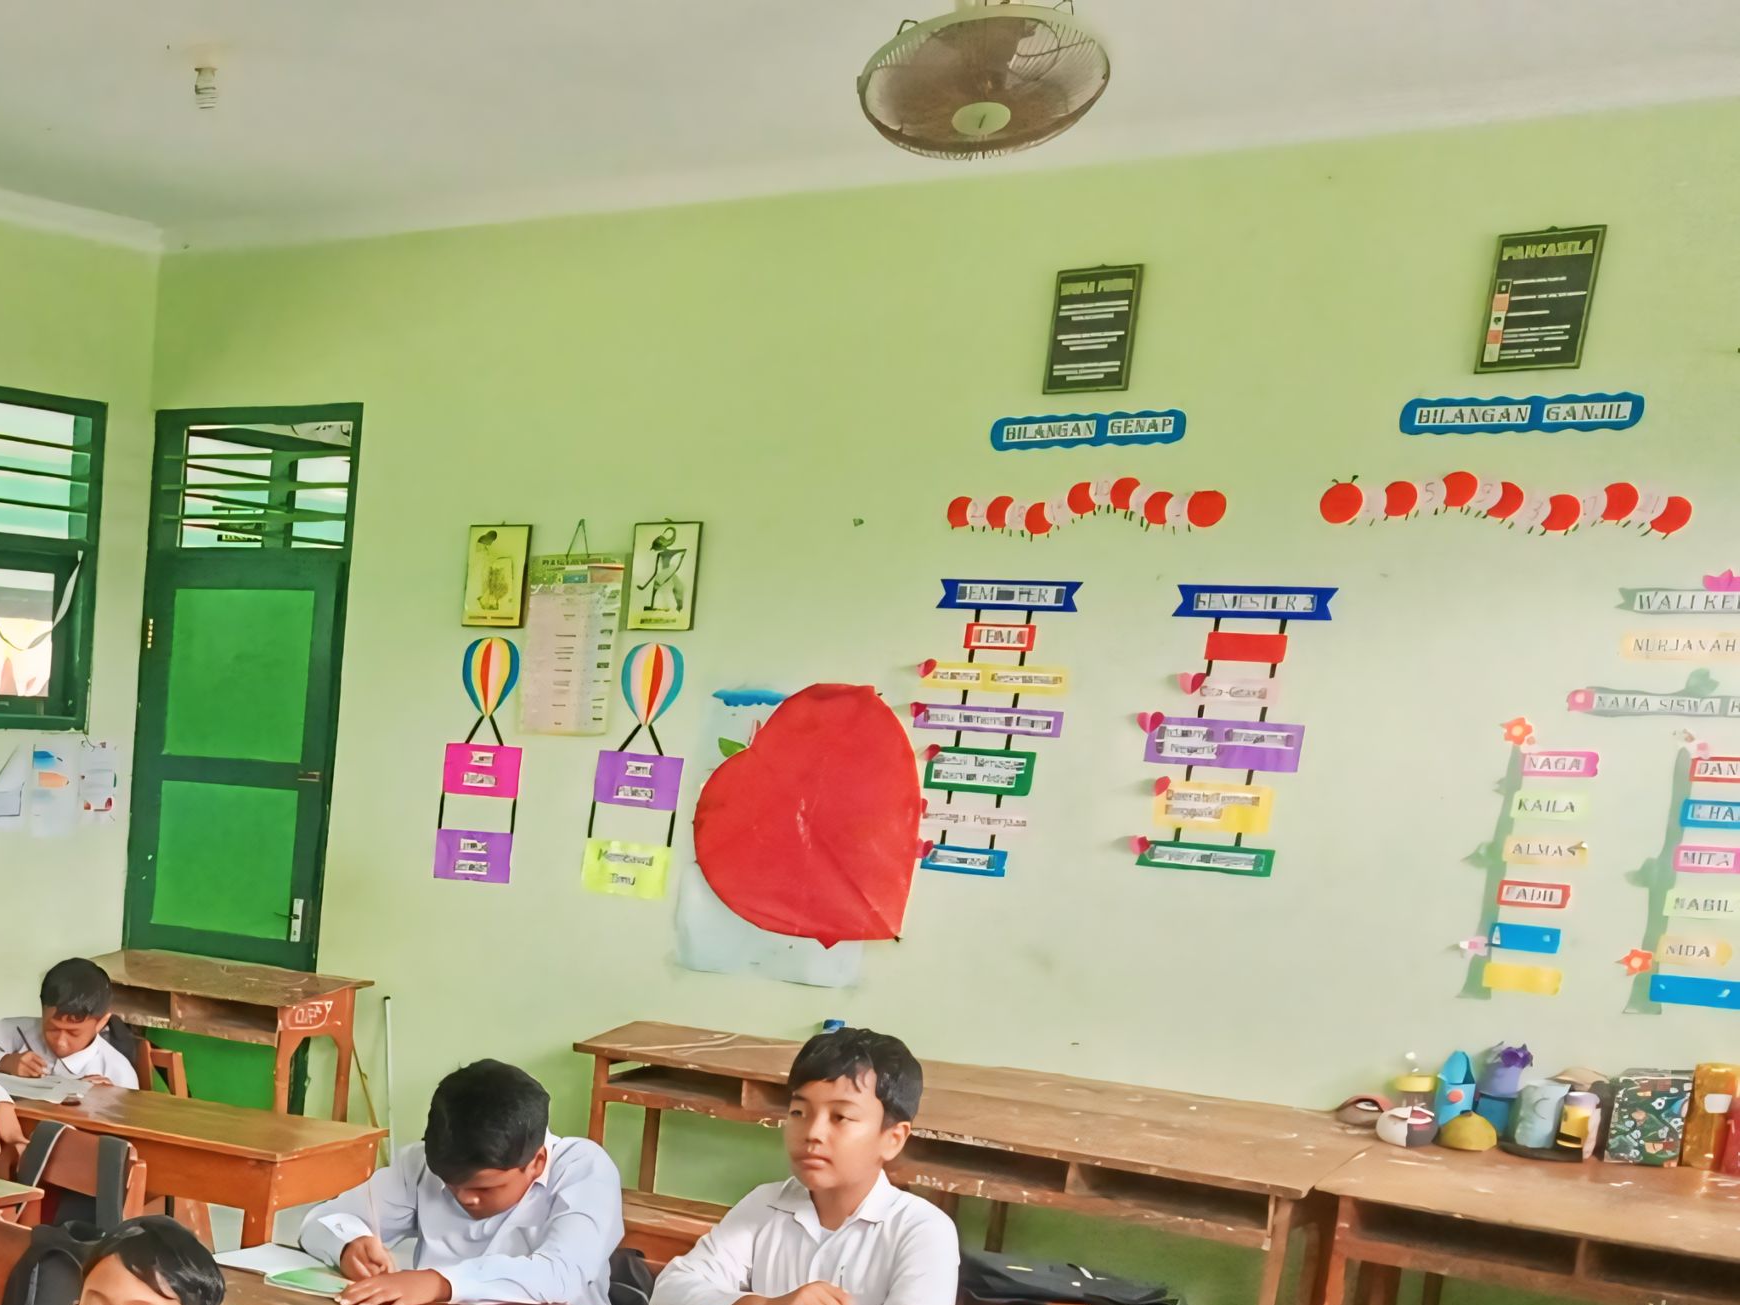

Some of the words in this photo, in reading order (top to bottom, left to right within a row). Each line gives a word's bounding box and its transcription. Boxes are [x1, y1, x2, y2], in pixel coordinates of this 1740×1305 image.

[1417, 406, 1529, 424] BILANGAN
[1545, 404, 1628, 421] GANJIL
[1005, 420, 1095, 441] BILANGAN
[1109, 418, 1173, 435] GENAP
[1639, 591, 1696, 610] WALI
[1597, 695, 1650, 711] NAMA
[1527, 756, 1583, 771] NAGA
[1517, 797, 1575, 814] KAILA
[1682, 851, 1730, 867] MITA
